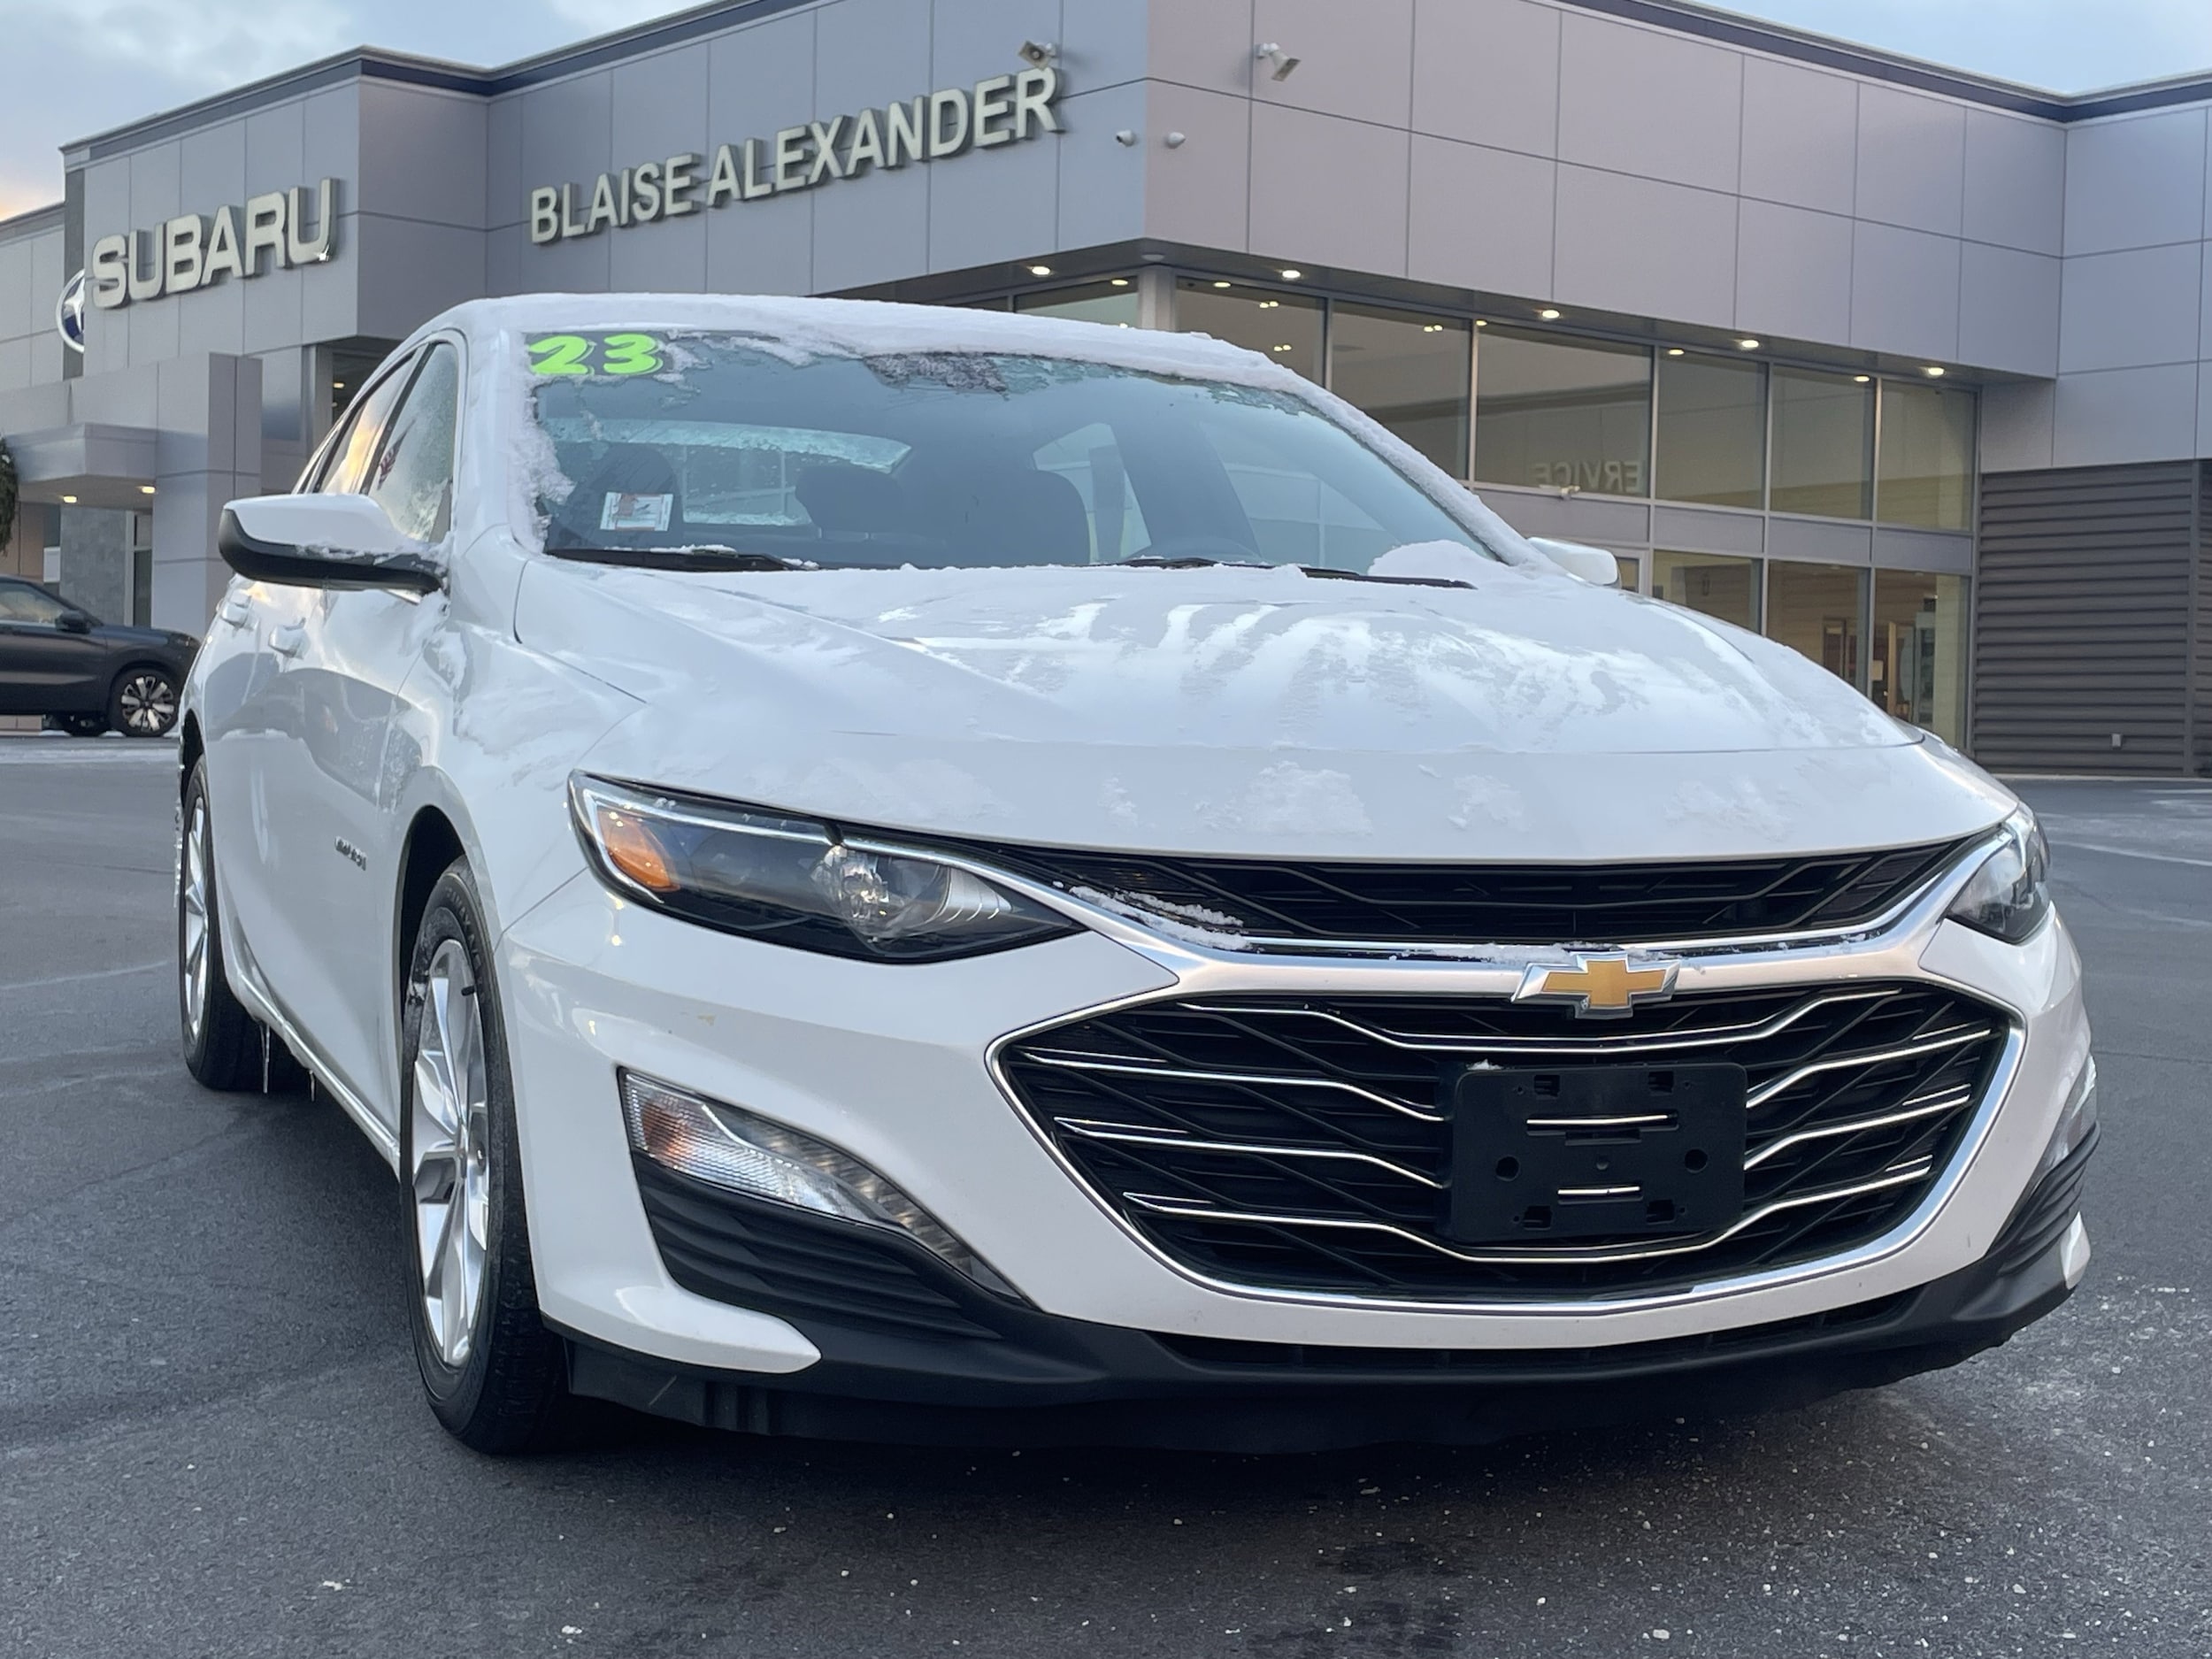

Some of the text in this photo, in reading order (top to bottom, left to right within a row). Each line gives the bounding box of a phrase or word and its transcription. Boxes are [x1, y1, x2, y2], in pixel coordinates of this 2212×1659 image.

[531, 66, 1062, 244] BLAISE ALEXANDER
[92, 177, 339, 309] SUBARU
[528, 333, 663, 375] 23
